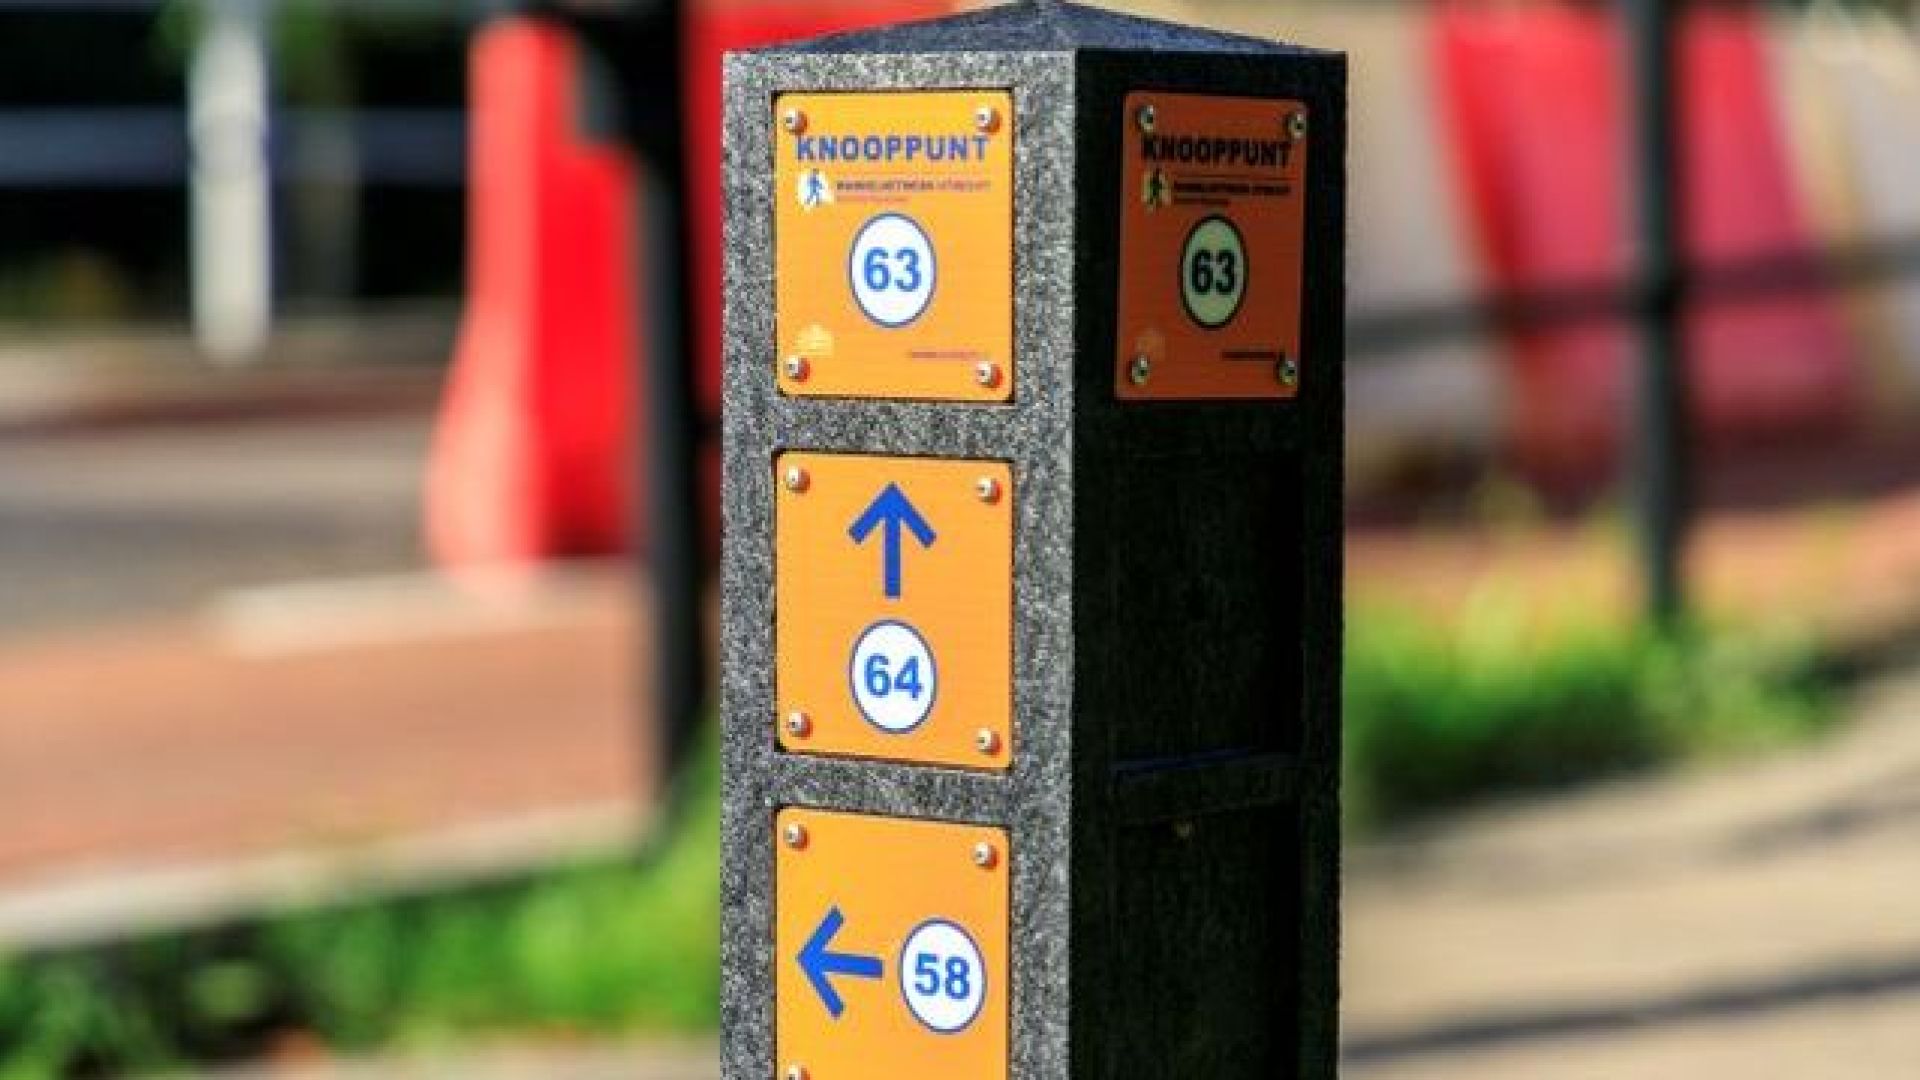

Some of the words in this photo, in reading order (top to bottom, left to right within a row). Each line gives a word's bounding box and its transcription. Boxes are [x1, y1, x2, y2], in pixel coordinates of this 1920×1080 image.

[797, 134, 988, 161] KNOOPPUNT
[1142, 135, 1290, 166] KNOOPPUNT
[864, 247, 921, 292] 63
[1192, 250, 1236, 295] 63
[864, 653, 923, 699] 64
[915, 953, 970, 999] 58
